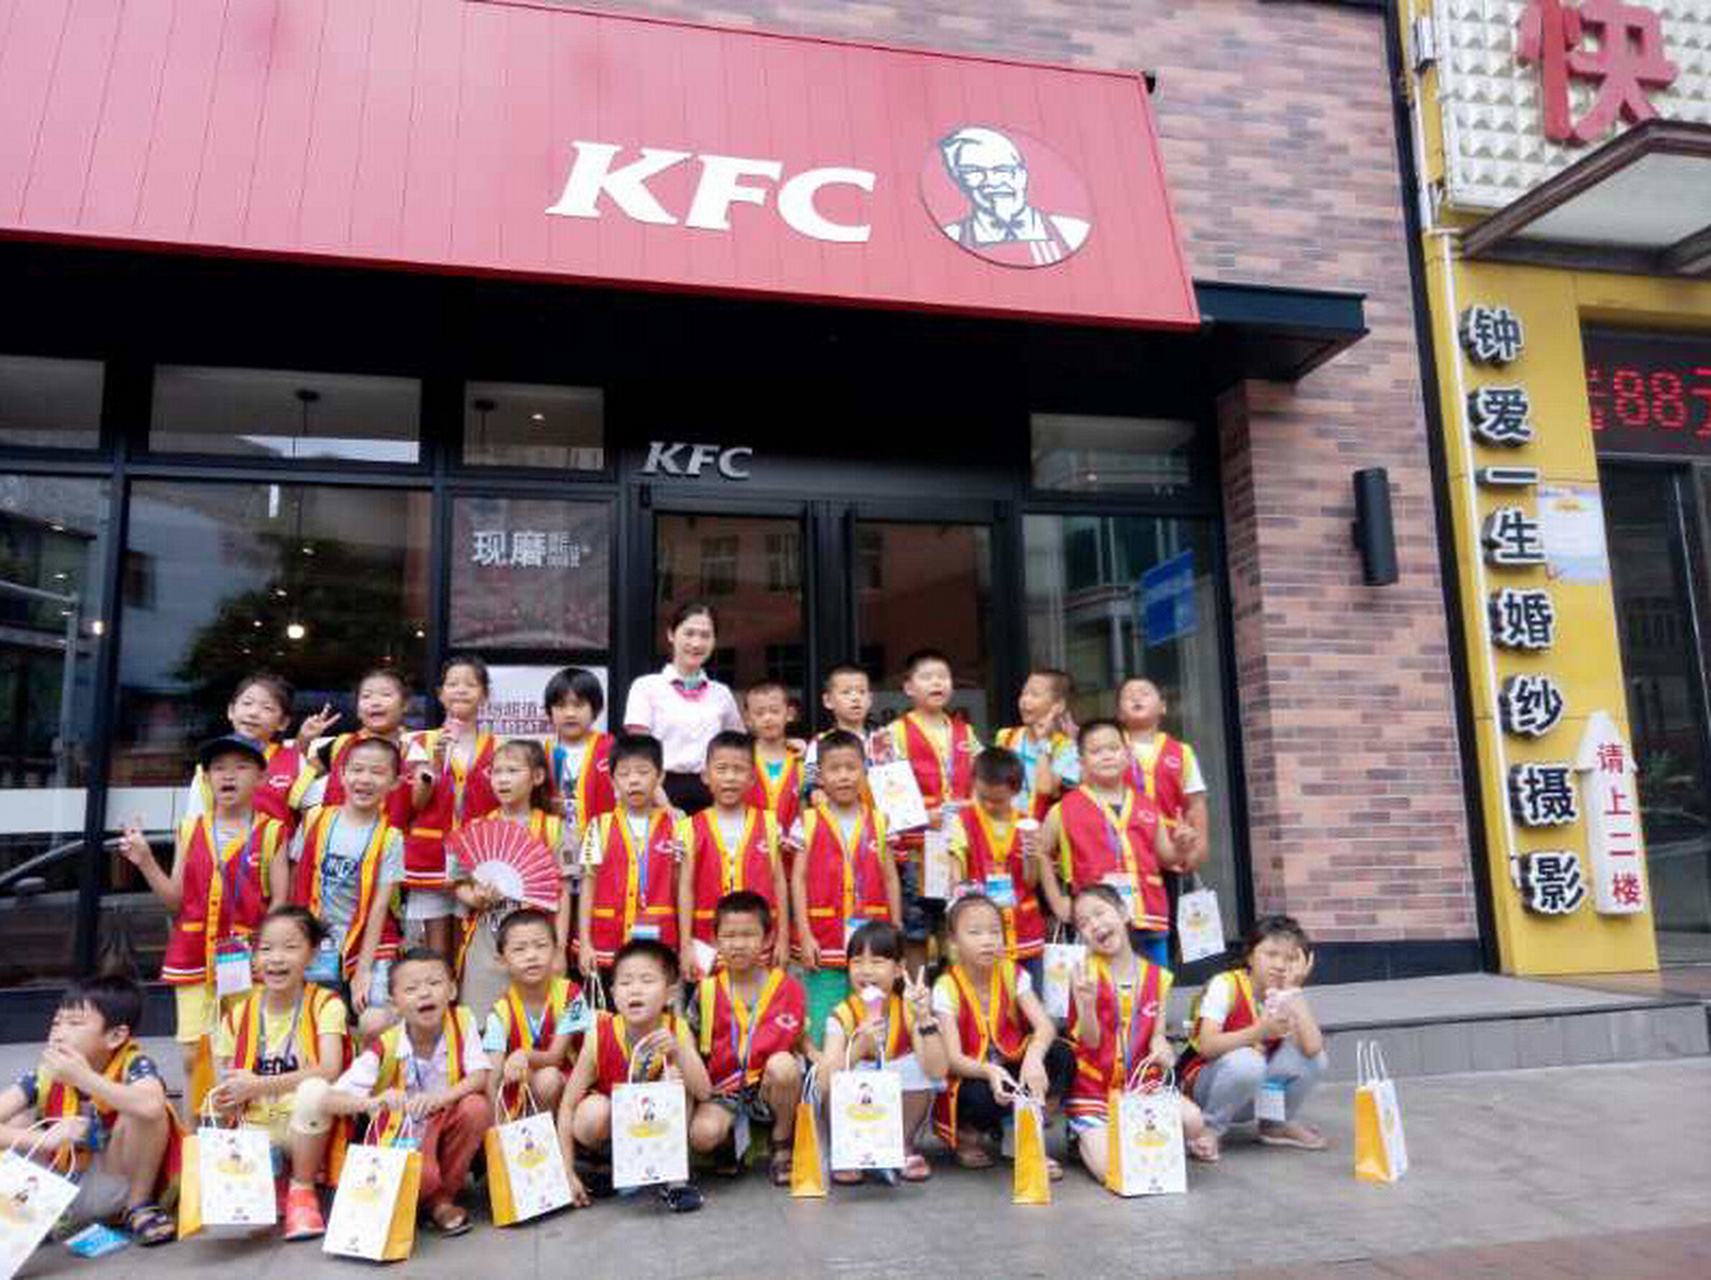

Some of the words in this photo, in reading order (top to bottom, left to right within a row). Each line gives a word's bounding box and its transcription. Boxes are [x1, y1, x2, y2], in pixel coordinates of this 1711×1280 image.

[1517, 0, 1678, 148] 快
[545, 140, 876, 243] KFC
[640, 440, 753, 479] KFC
[1464, 306, 1585, 914] 钟爱一生婚纱摄影
[1597, 742, 1642, 906] 请上二楼
